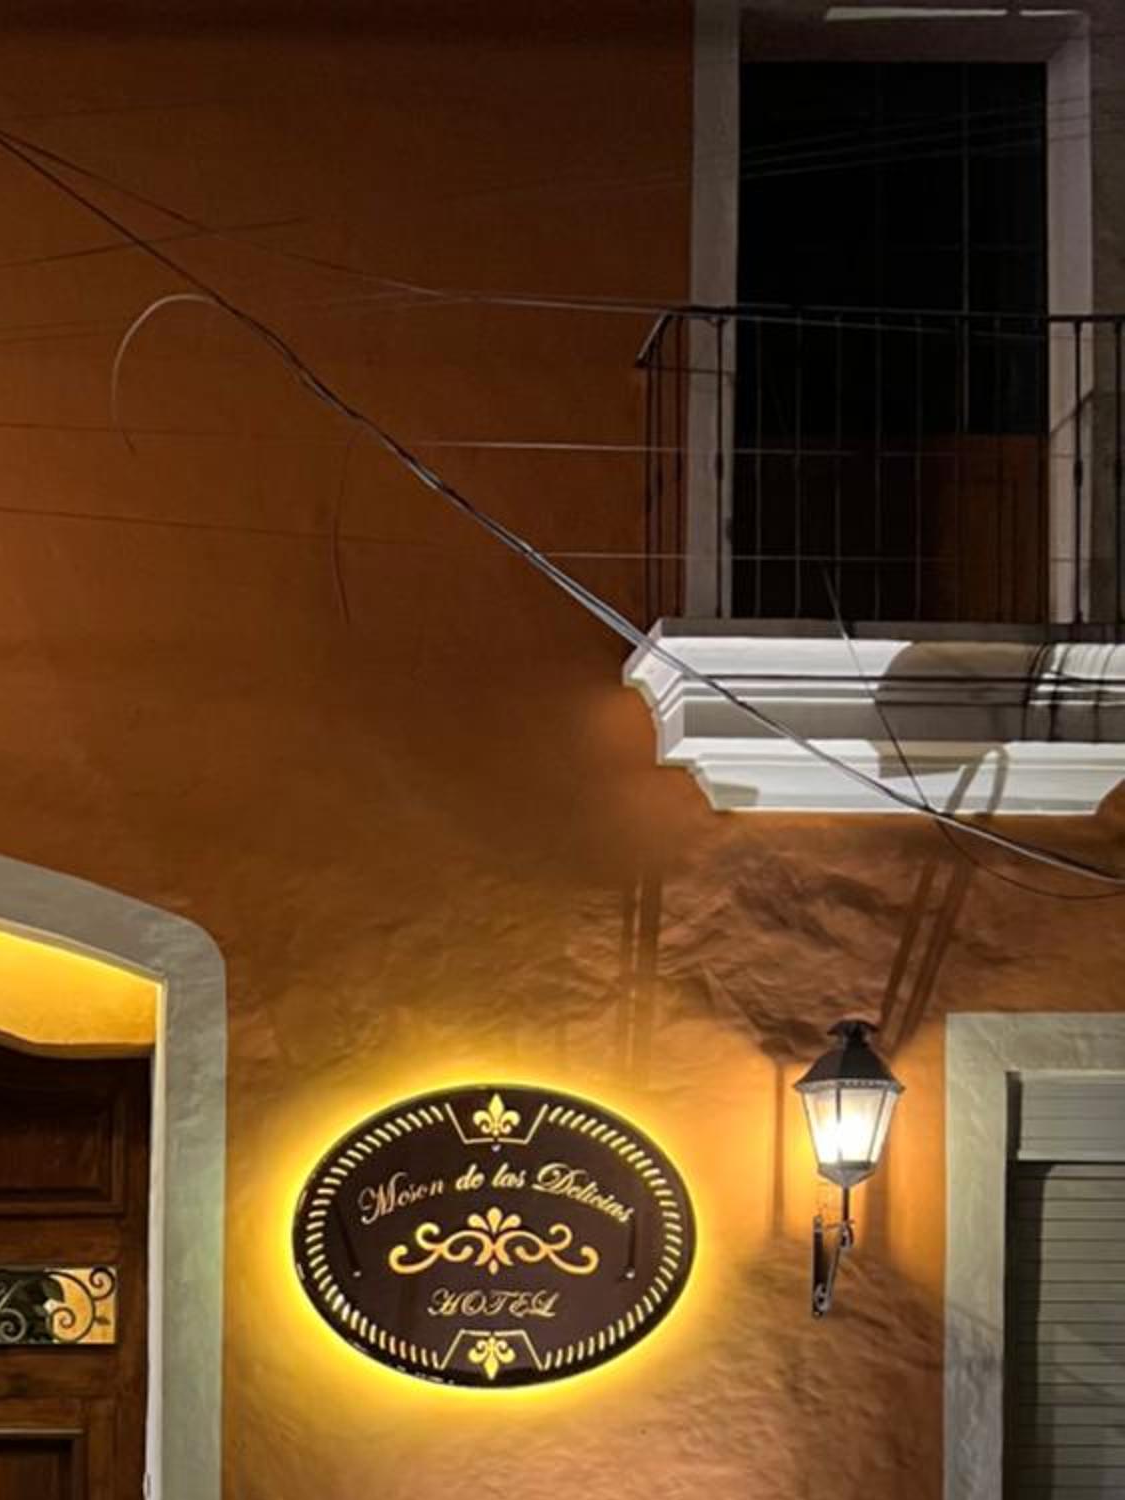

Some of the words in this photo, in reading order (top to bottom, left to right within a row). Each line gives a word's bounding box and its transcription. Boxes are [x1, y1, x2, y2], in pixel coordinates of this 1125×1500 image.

[455, 1163, 485, 1191] de
[491, 1162, 527, 1188] las
[531, 1162, 635, 1223] Delicias
[426, 1287, 560, 1318] HOTEL
